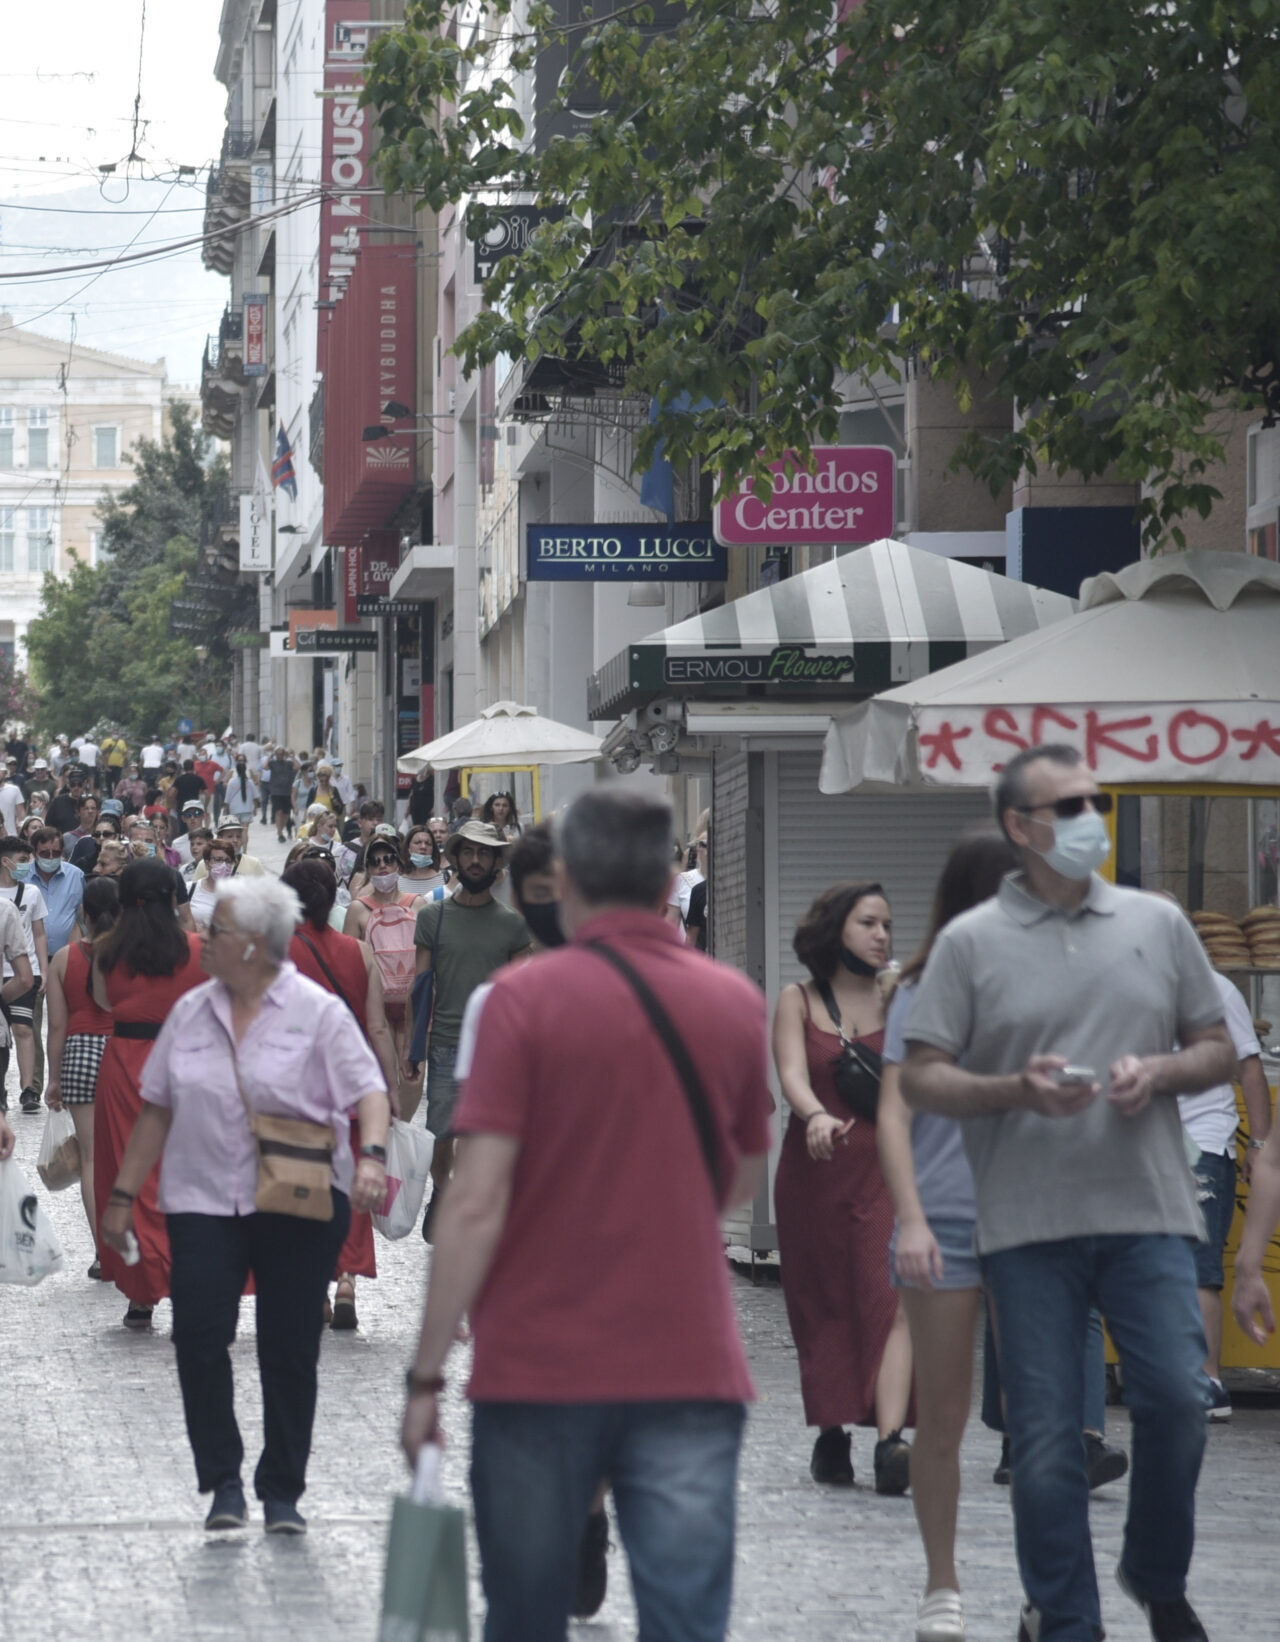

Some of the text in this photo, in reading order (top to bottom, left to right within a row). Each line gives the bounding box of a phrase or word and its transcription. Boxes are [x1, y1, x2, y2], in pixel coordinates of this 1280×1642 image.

[380, 285, 396, 424] UKYBUDDHA
[734, 494, 864, 532] Center
[539, 538, 713, 558] BERTO LUCCI
[348, 568, 357, 597] LAPIN
[584, 563, 669, 573] MILANO
[669, 649, 853, 680] ERMOU Flower
